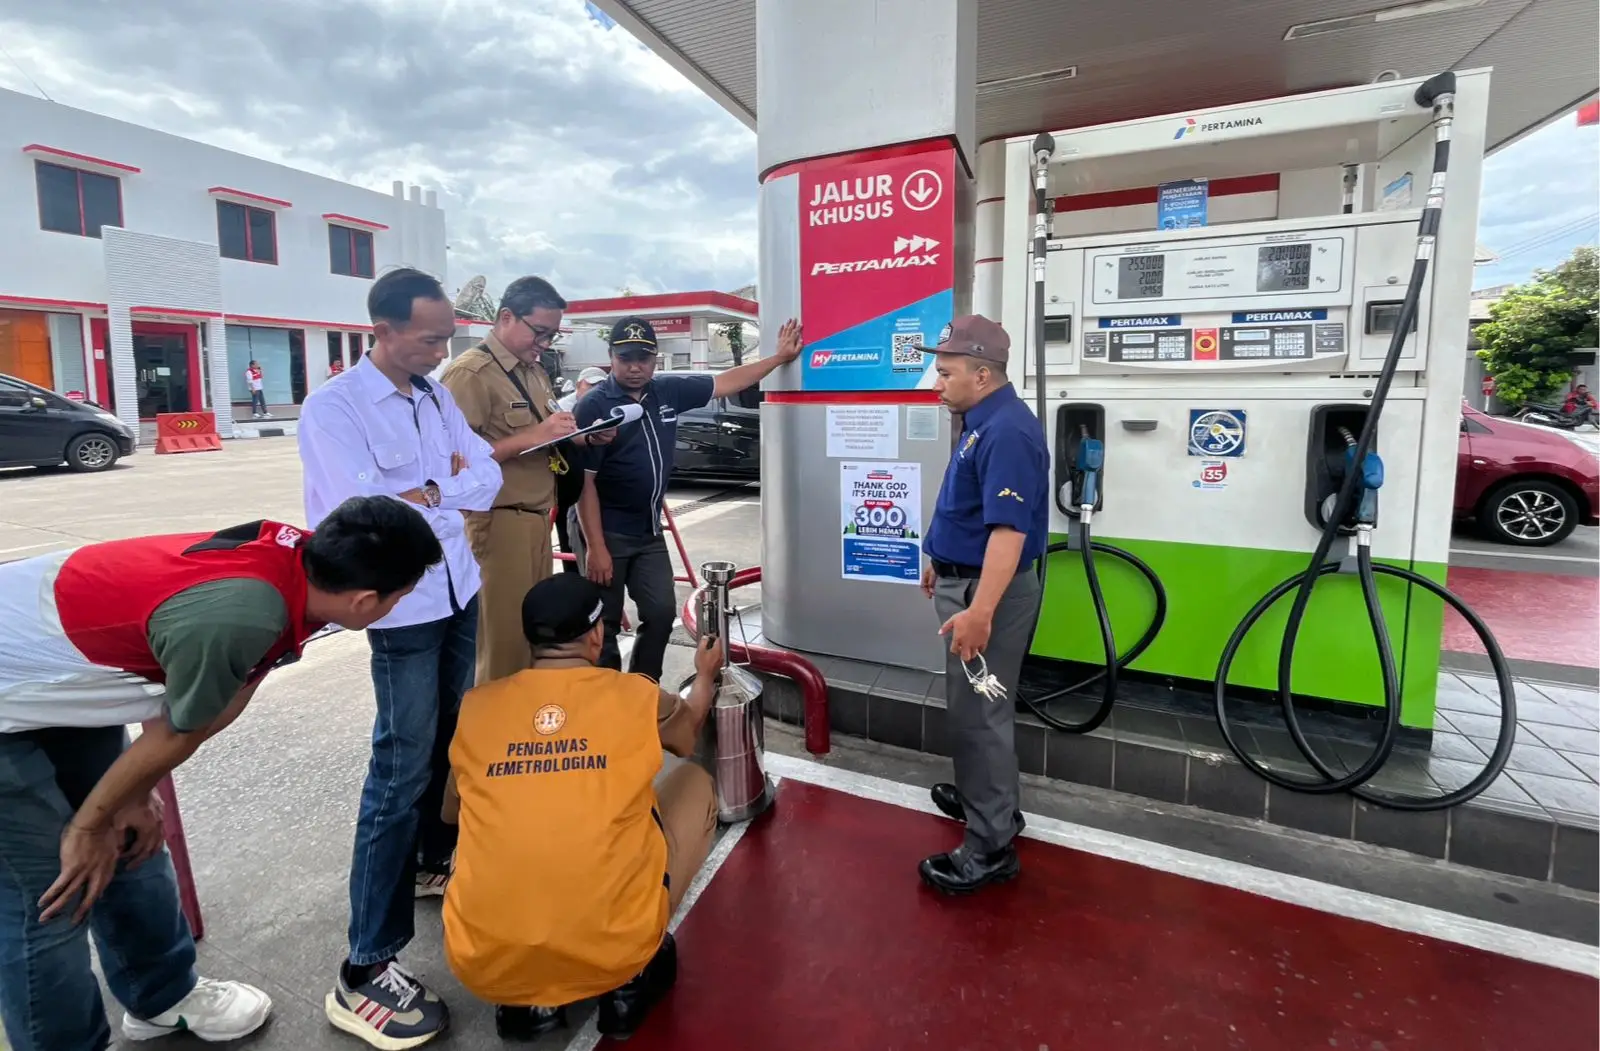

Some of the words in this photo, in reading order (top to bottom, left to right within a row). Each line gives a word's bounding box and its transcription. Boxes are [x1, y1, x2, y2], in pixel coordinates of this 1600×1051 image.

[1201, 117, 1263, 132] PERTAMINA
[810, 174, 893, 206] JALUR
[810, 200, 893, 227] KHUSUS
[810, 253, 940, 276] PERTAMAX
[1110, 316, 1169, 326] PERTAMAX
[1245, 311, 1313, 321] PERTAMAX
[852, 489, 866, 497] IT'S
[867, 490, 887, 498] FUEL
[889, 491, 909, 499] DAY
[853, 481, 884, 489] THANK
[886, 482, 907, 490] GOD
[855, 506, 904, 527] 300
[507, 738, 588, 757] PENGAWAS
[486, 755, 607, 777] KEMETROLOGIAN
